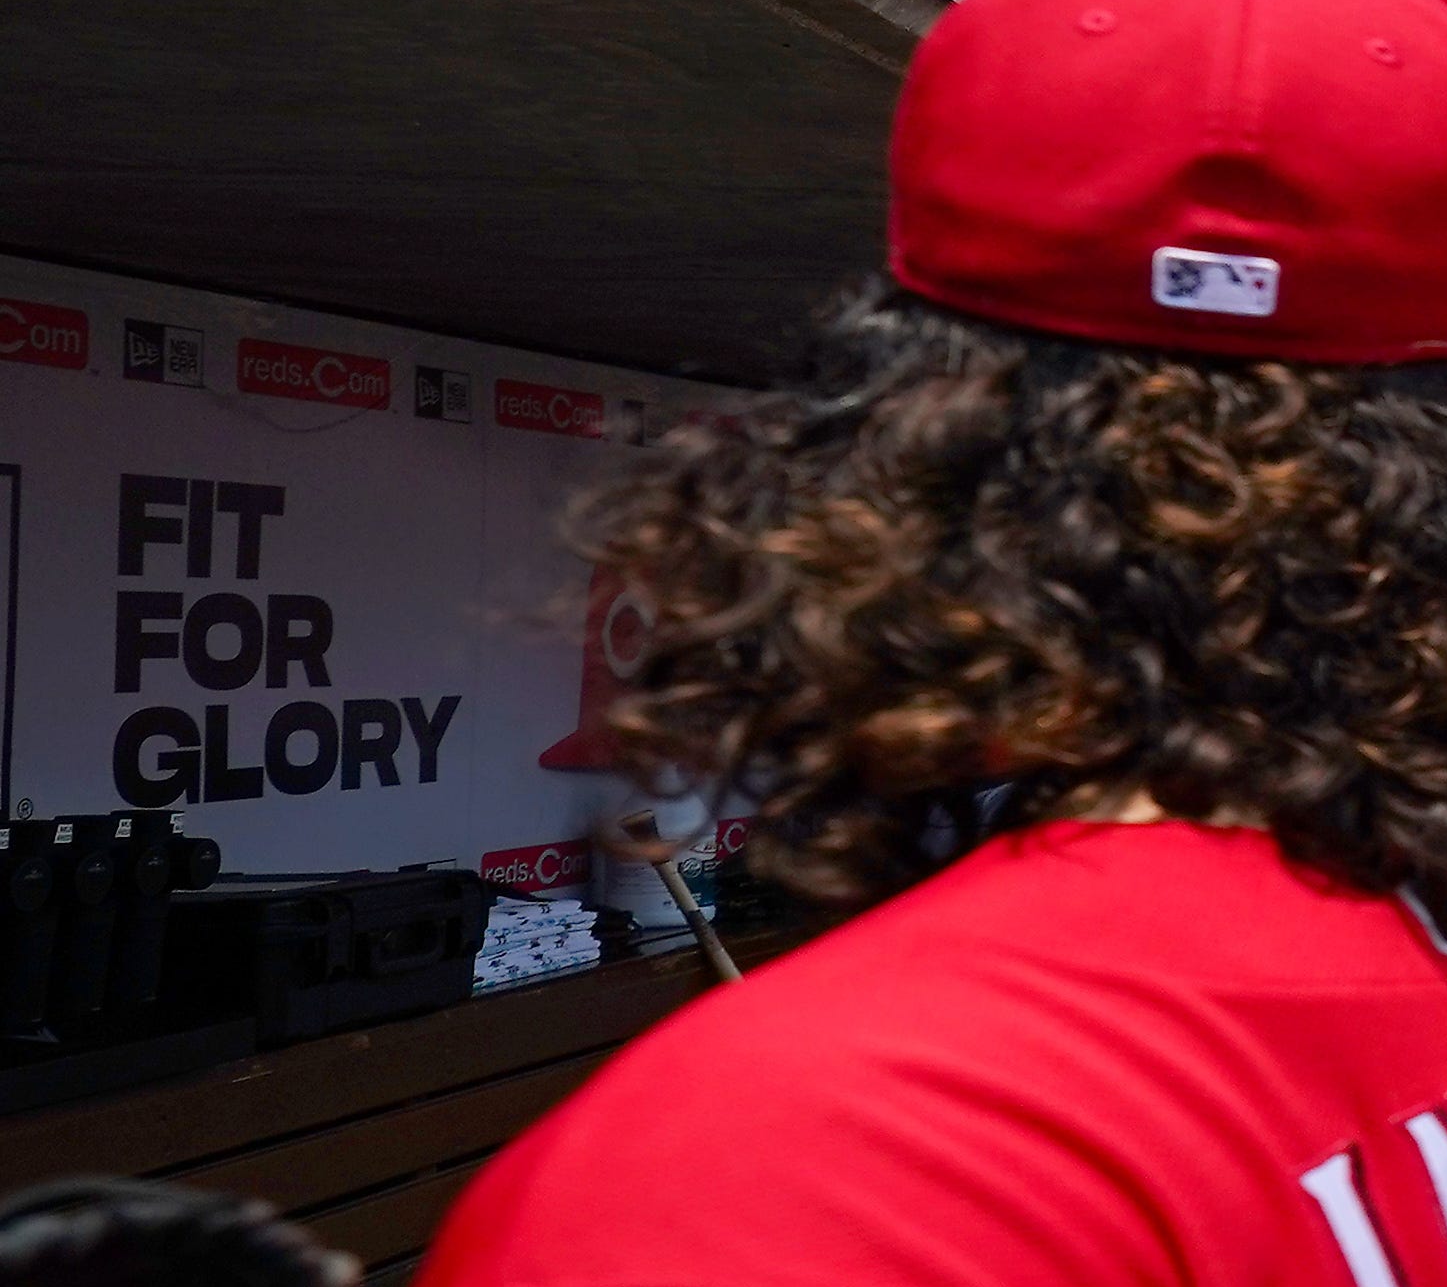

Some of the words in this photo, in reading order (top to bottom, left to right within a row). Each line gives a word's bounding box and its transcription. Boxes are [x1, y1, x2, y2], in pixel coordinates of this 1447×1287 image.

[242, 354, 386, 398] reds.Com
[119, 473, 286, 580] FIT
[114, 590, 334, 695] FOR
[112, 695, 462, 808] GLORY
